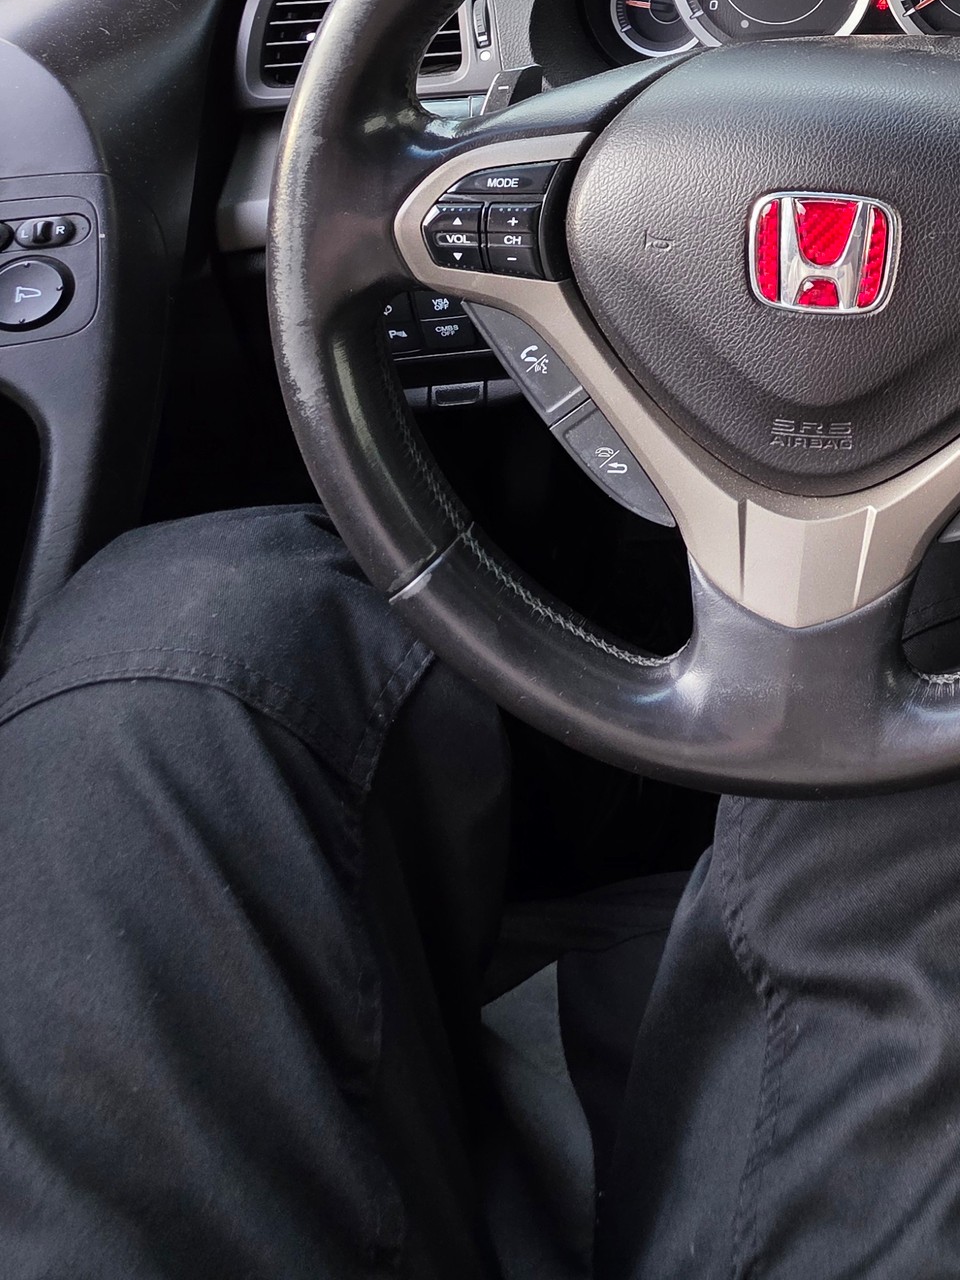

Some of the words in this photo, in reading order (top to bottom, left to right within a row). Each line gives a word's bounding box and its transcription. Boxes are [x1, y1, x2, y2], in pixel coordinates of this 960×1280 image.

[709, 0, 718, 10] 0
[487, 178, 519, 187] MODE
[21, 230, 28, 238] L
[56, 226, 65, 234] R
[446, 235, 470, 244] VOL
[504, 236, 521, 244] CH
[435, 324, 459, 333] CMBS
[770, 437, 852, 450] AIRBAG
